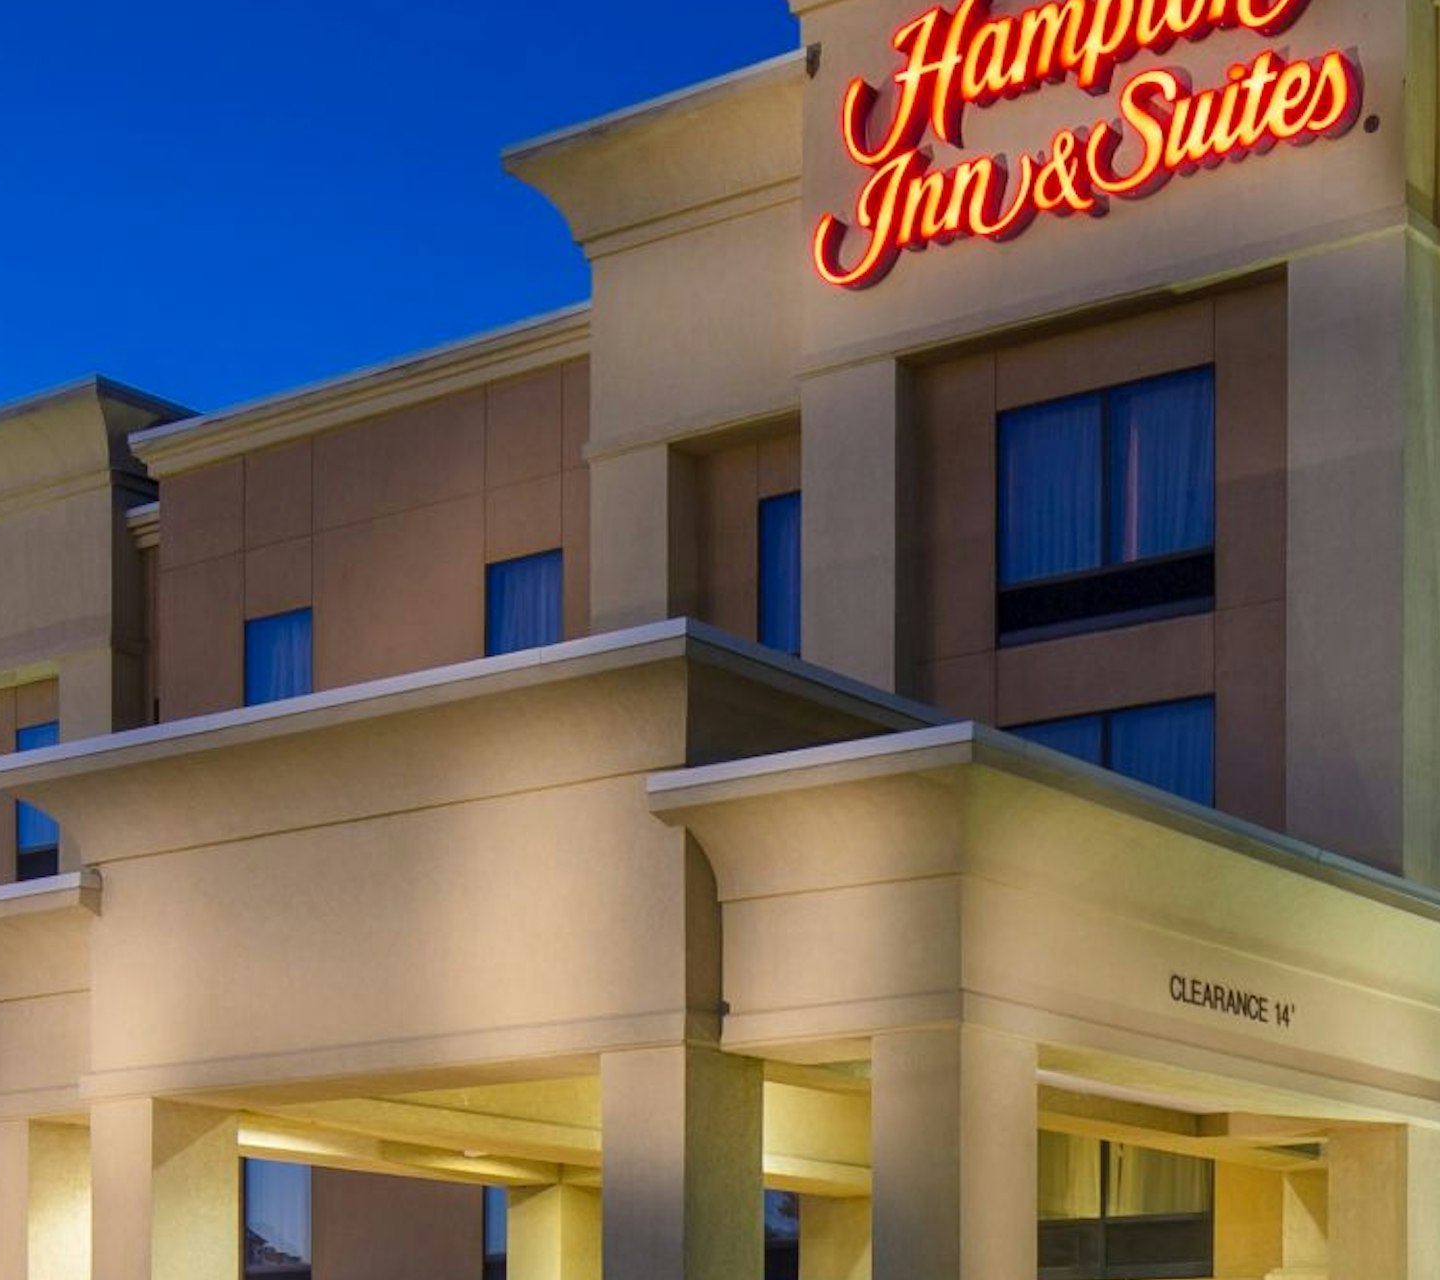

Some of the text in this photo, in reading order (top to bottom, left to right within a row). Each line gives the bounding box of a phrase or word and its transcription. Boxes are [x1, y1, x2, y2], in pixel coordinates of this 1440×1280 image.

[814, 49, 1356, 287] Inn & Suites
[1170, 975, 1295, 1028] CLEARANCE 14'
